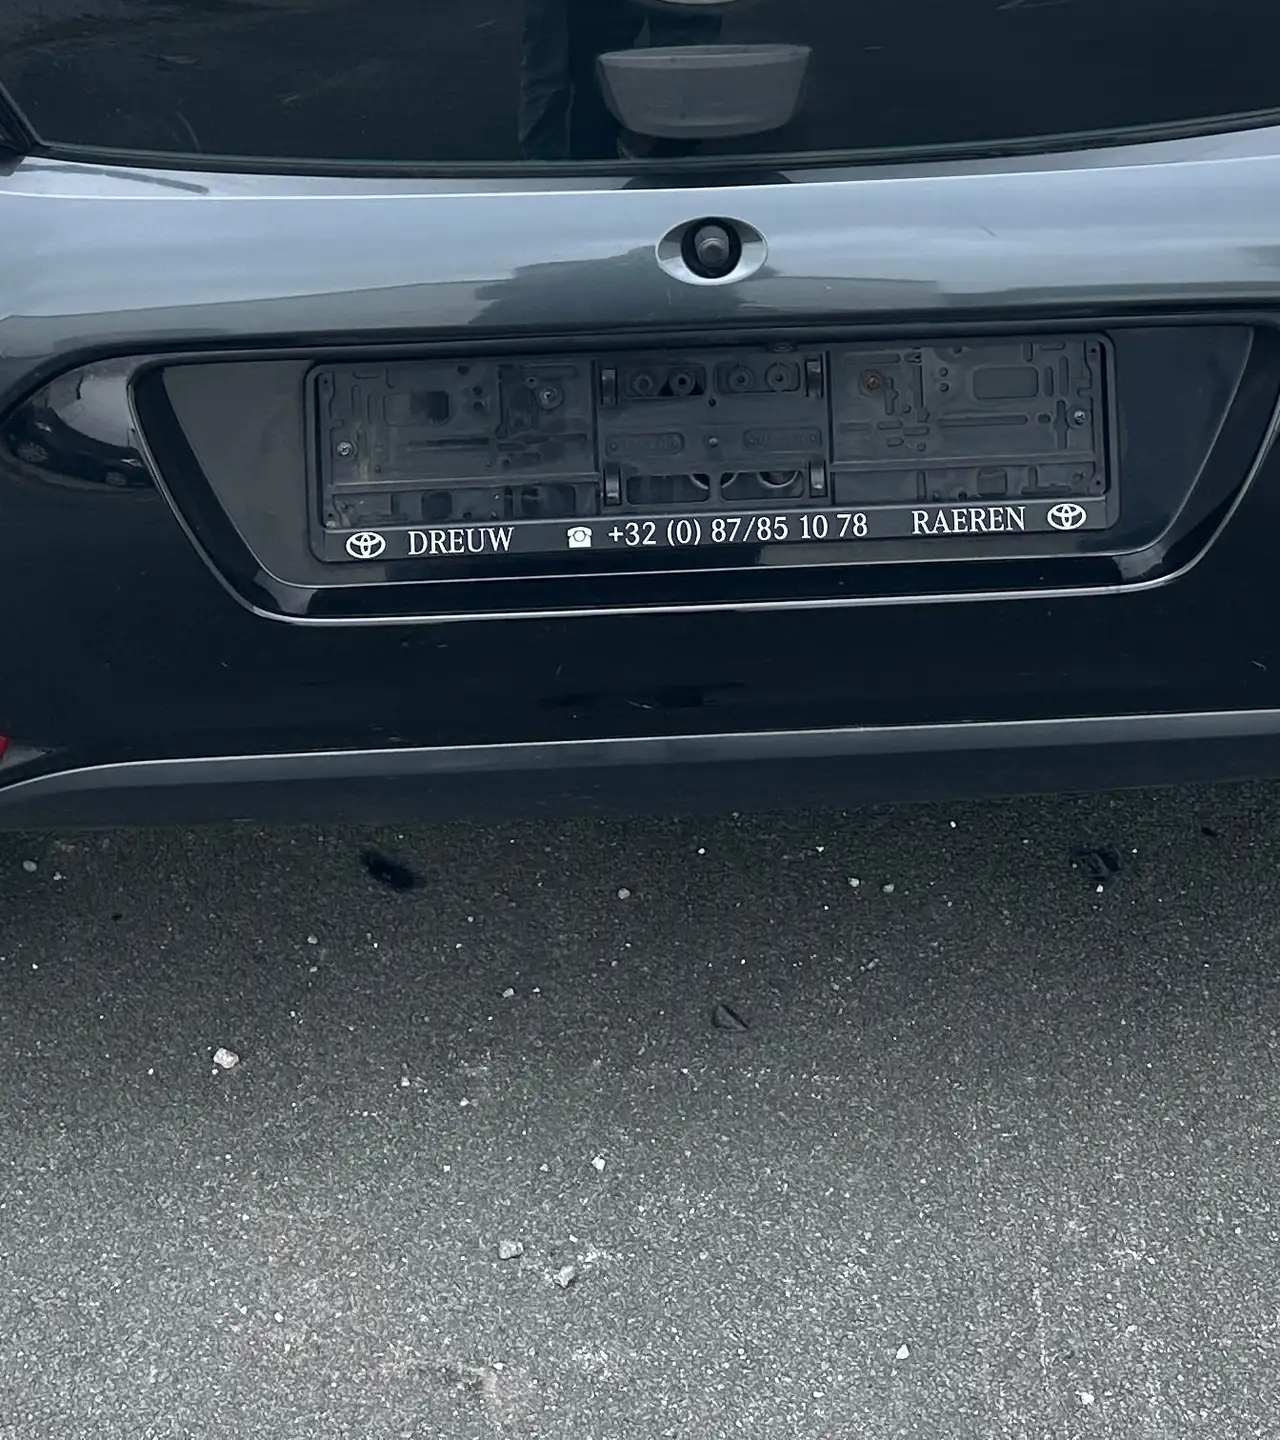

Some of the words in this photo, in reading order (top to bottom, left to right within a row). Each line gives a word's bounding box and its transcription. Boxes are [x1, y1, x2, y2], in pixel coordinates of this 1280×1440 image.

[408, 526, 515, 556] DREUW
[607, 521, 657, 546] +32
[667, 518, 702, 546] (0)
[710, 515, 789, 543] 87/85
[799, 514, 829, 540] 10
[836, 512, 869, 538] 78
[911, 506, 1027, 535] RAEREN
